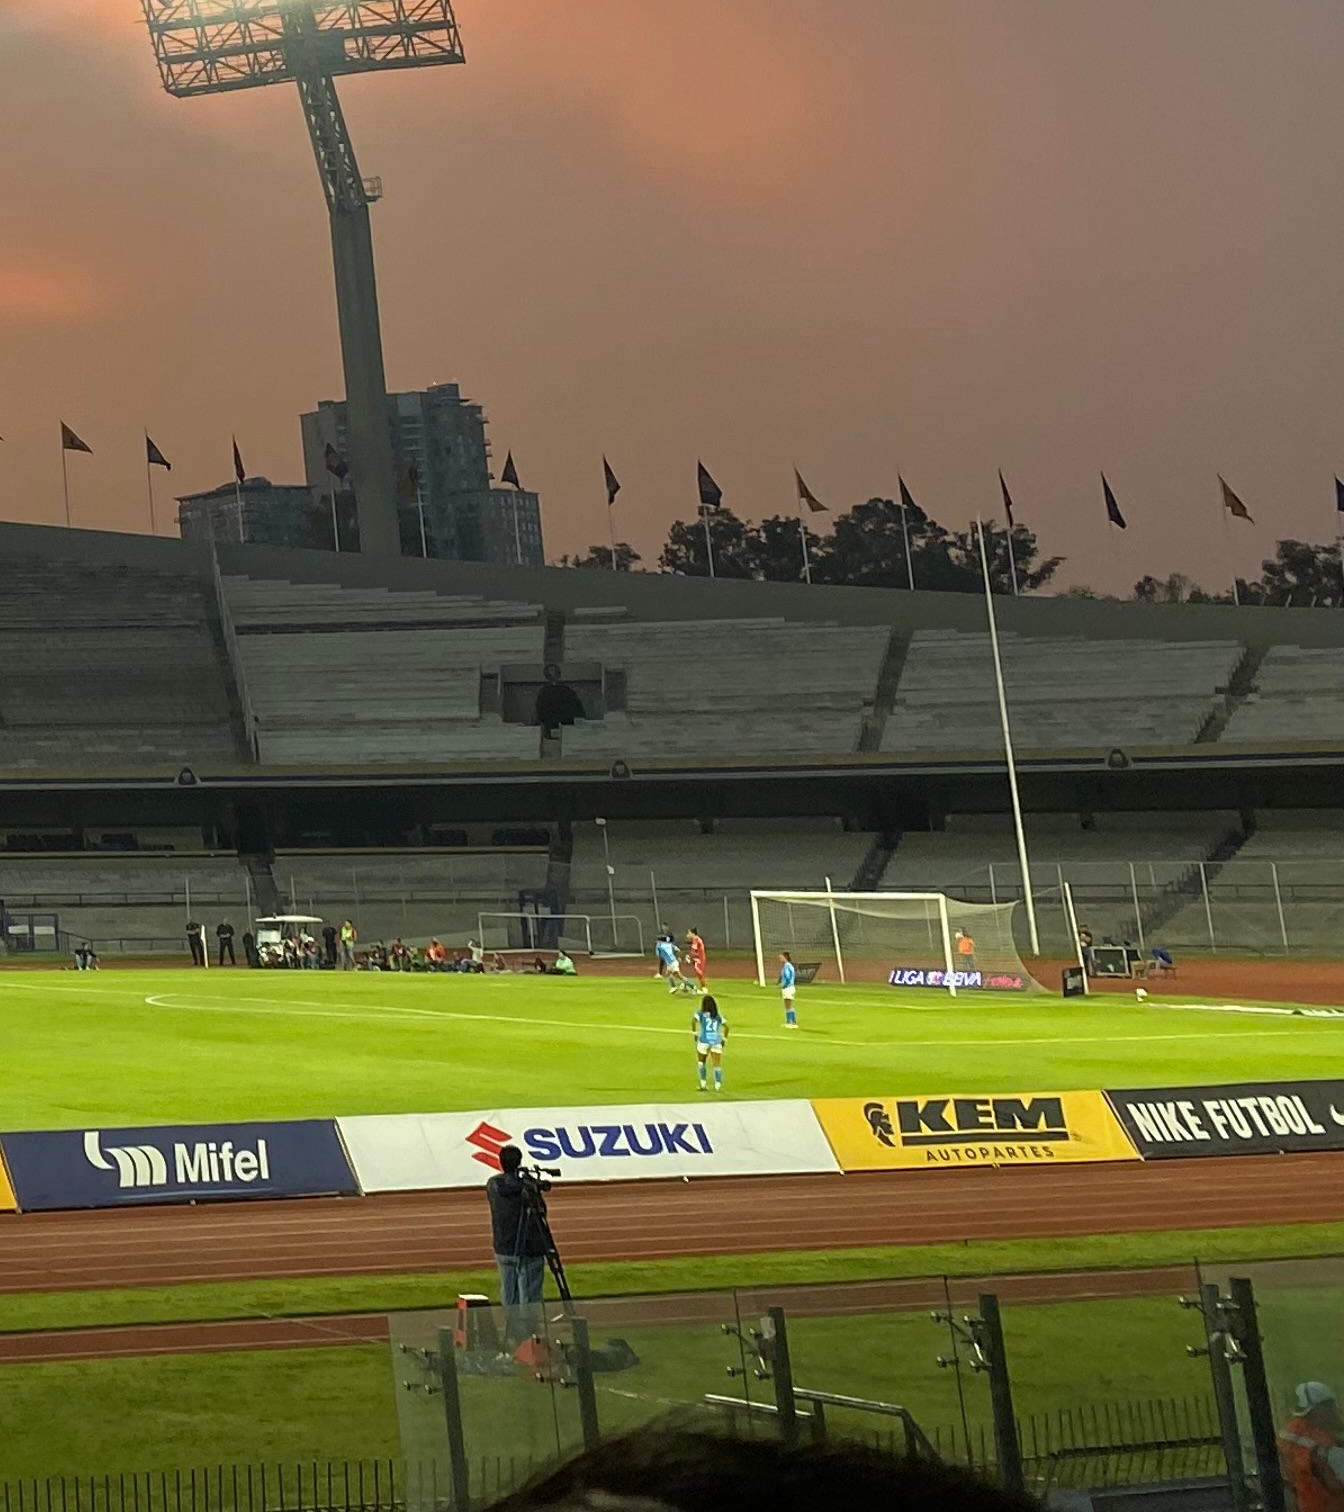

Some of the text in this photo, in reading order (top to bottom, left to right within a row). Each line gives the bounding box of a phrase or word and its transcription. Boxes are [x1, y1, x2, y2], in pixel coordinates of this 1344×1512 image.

[896, 1097, 1067, 1135] KEM
[1126, 1095, 1326, 1143] NIKE FUTBOL
[174, 1139, 270, 1184] Mifel
[523, 1123, 714, 1162] SUZUKI
[925, 1145, 1055, 1162] AUTOPARTES
